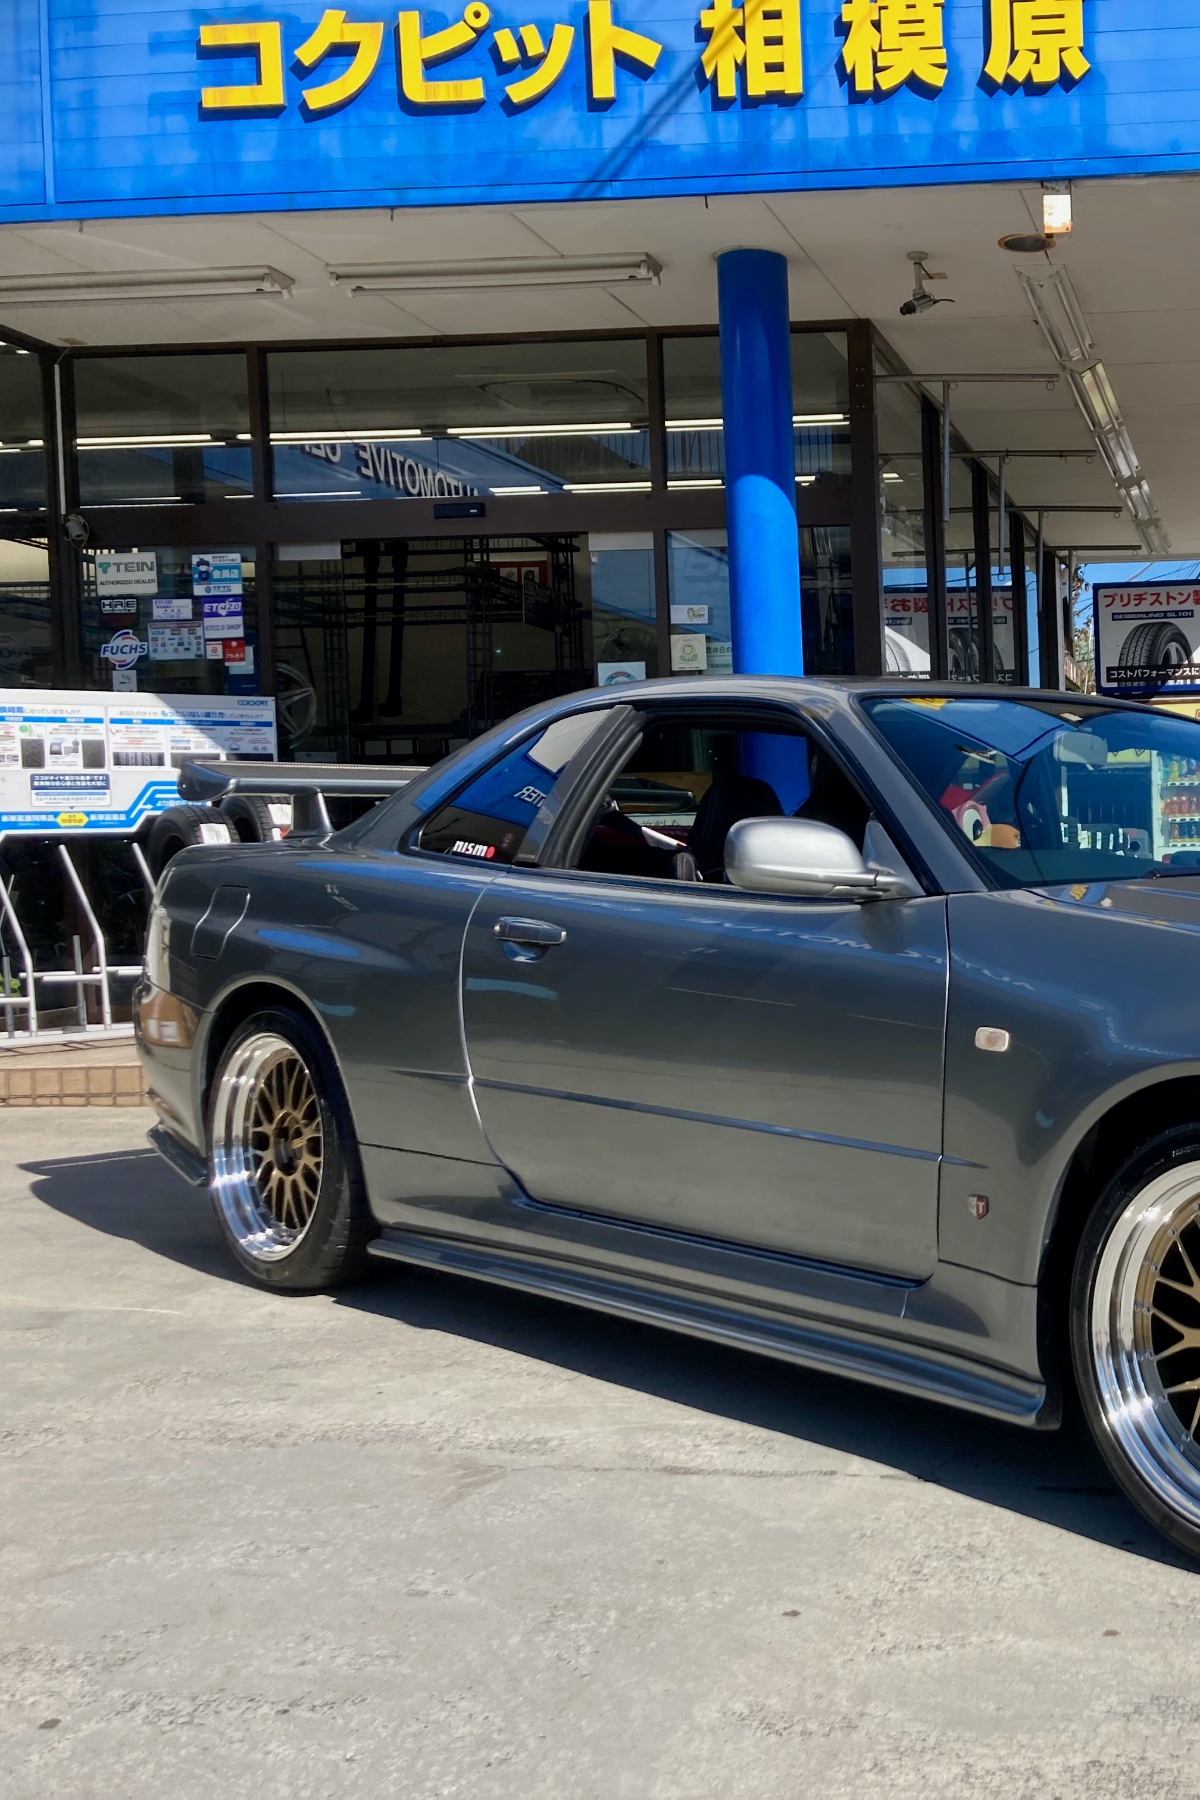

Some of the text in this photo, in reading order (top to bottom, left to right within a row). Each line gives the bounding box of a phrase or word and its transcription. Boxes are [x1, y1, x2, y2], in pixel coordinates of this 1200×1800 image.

[199, 0, 1092, 113] コクピット 相模原
[112, 561, 155, 573] TEIN
[102, 600, 137, 609] HRE
[1113, 612, 1165, 620] SEIBERLING
[101, 643, 148, 656] FUCHS
[237, 699, 269, 707] COCKPIT
